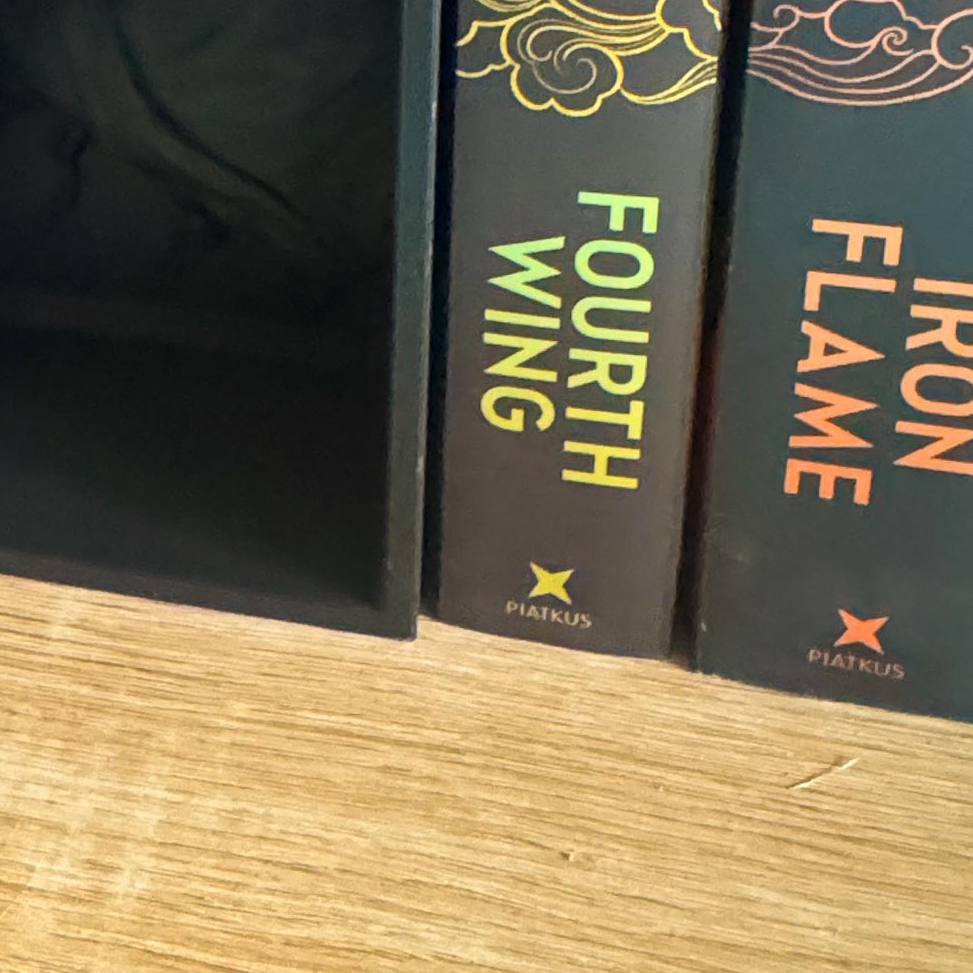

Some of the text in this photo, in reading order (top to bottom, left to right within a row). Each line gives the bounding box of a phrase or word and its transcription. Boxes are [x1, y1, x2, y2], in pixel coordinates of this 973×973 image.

[480, 235, 567, 433] WING
[561, 191, 660, 490] FOURTH
[783, 218, 904, 506] FLAME
[893, 277, 973, 477] IRON
[505, 599, 593, 630] PIATKUS
[808, 647, 907, 681] PIATKUS
